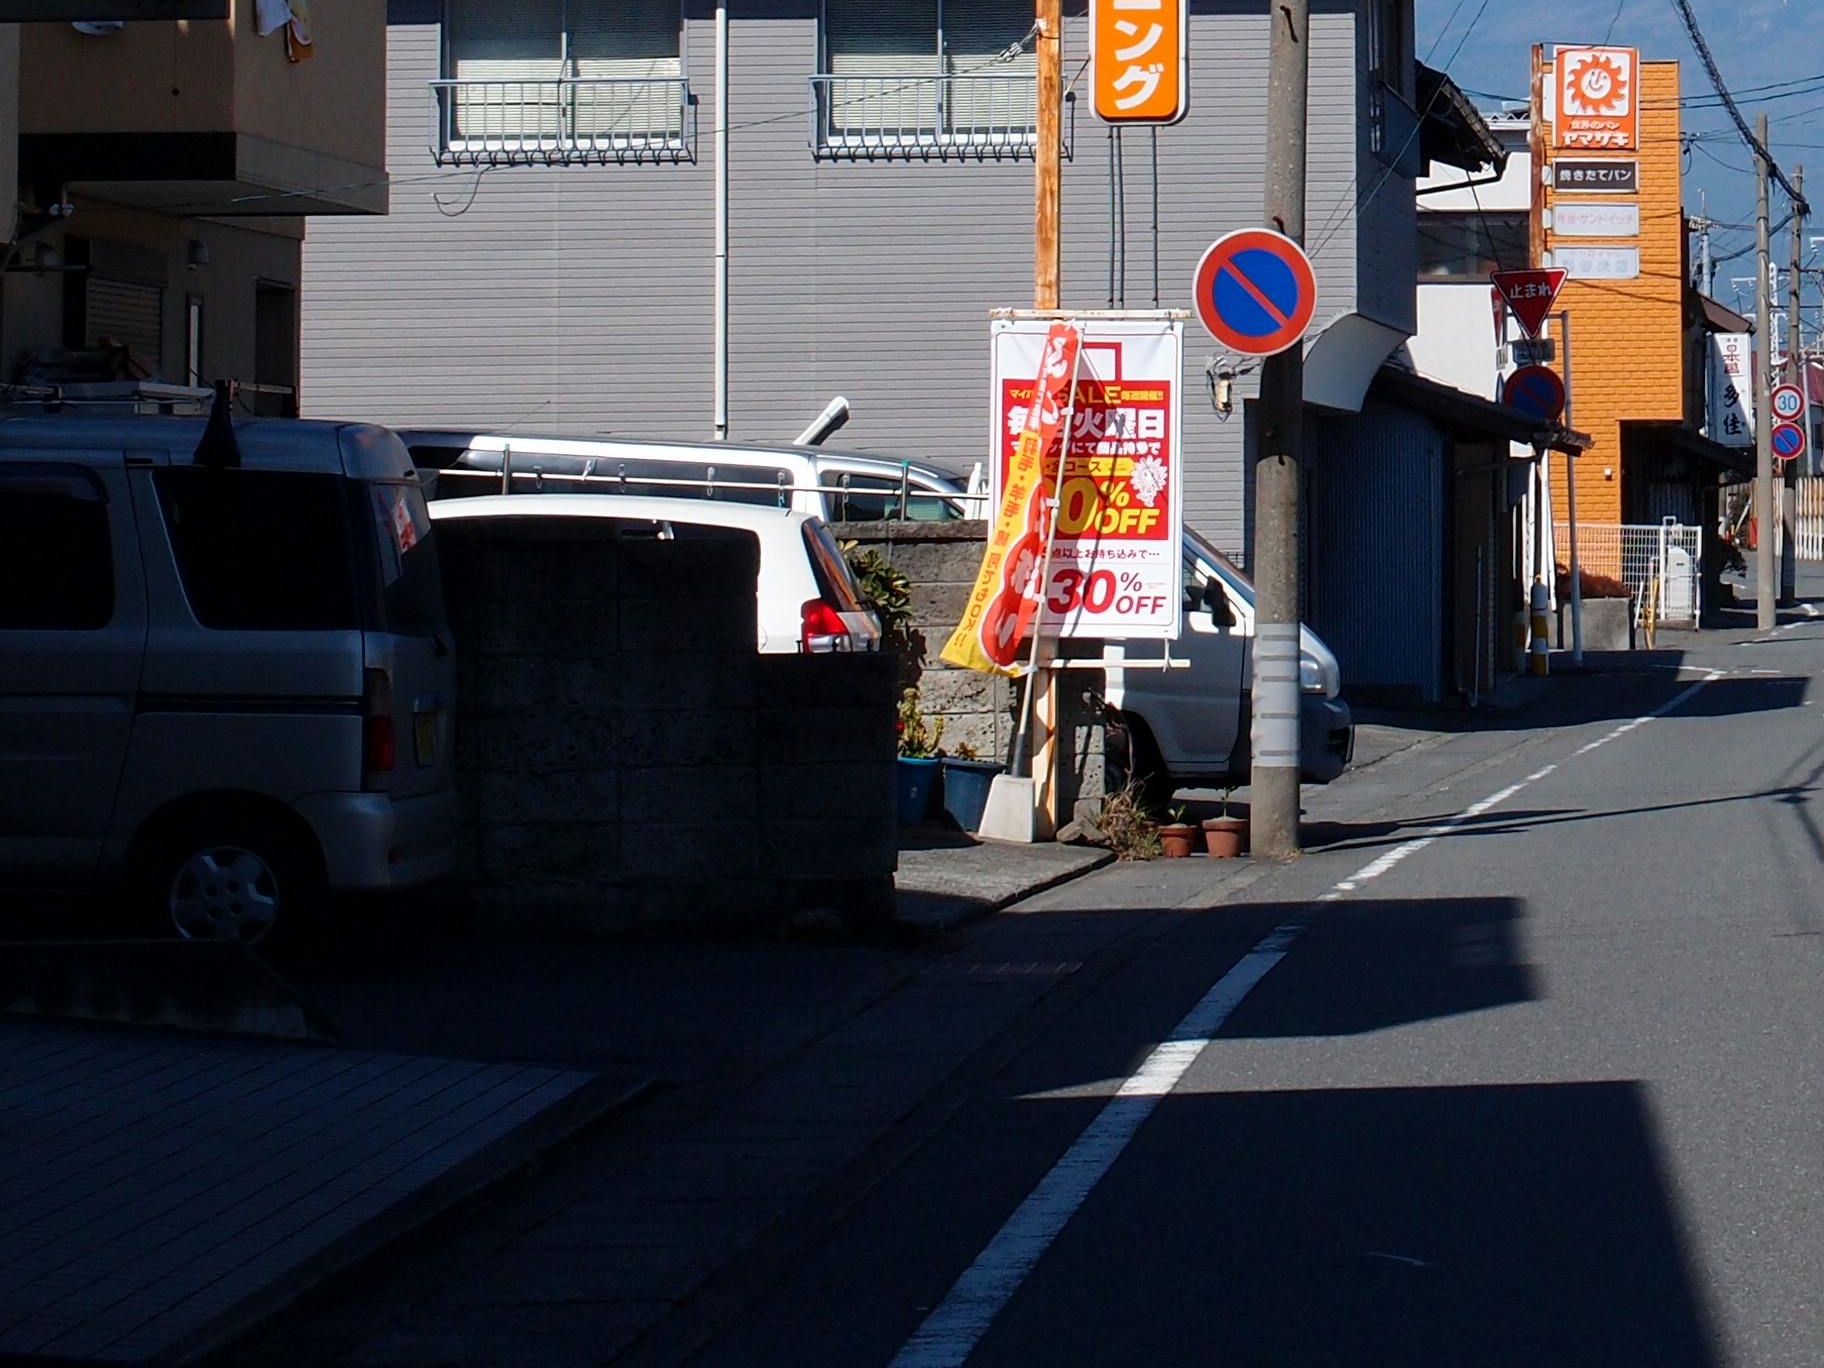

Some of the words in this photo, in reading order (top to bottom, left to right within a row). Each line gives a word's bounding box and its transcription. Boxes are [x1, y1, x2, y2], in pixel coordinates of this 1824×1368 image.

[1563, 131, 1629, 146] ヤマザキ
[1560, 169, 1632, 182] 焼きたてパン
[1509, 281, 1553, 299] 止まれ
[1778, 394, 1798, 411] 30
[1094, 509, 1161, 536] OFF
[1115, 595, 1168, 615] OFF
